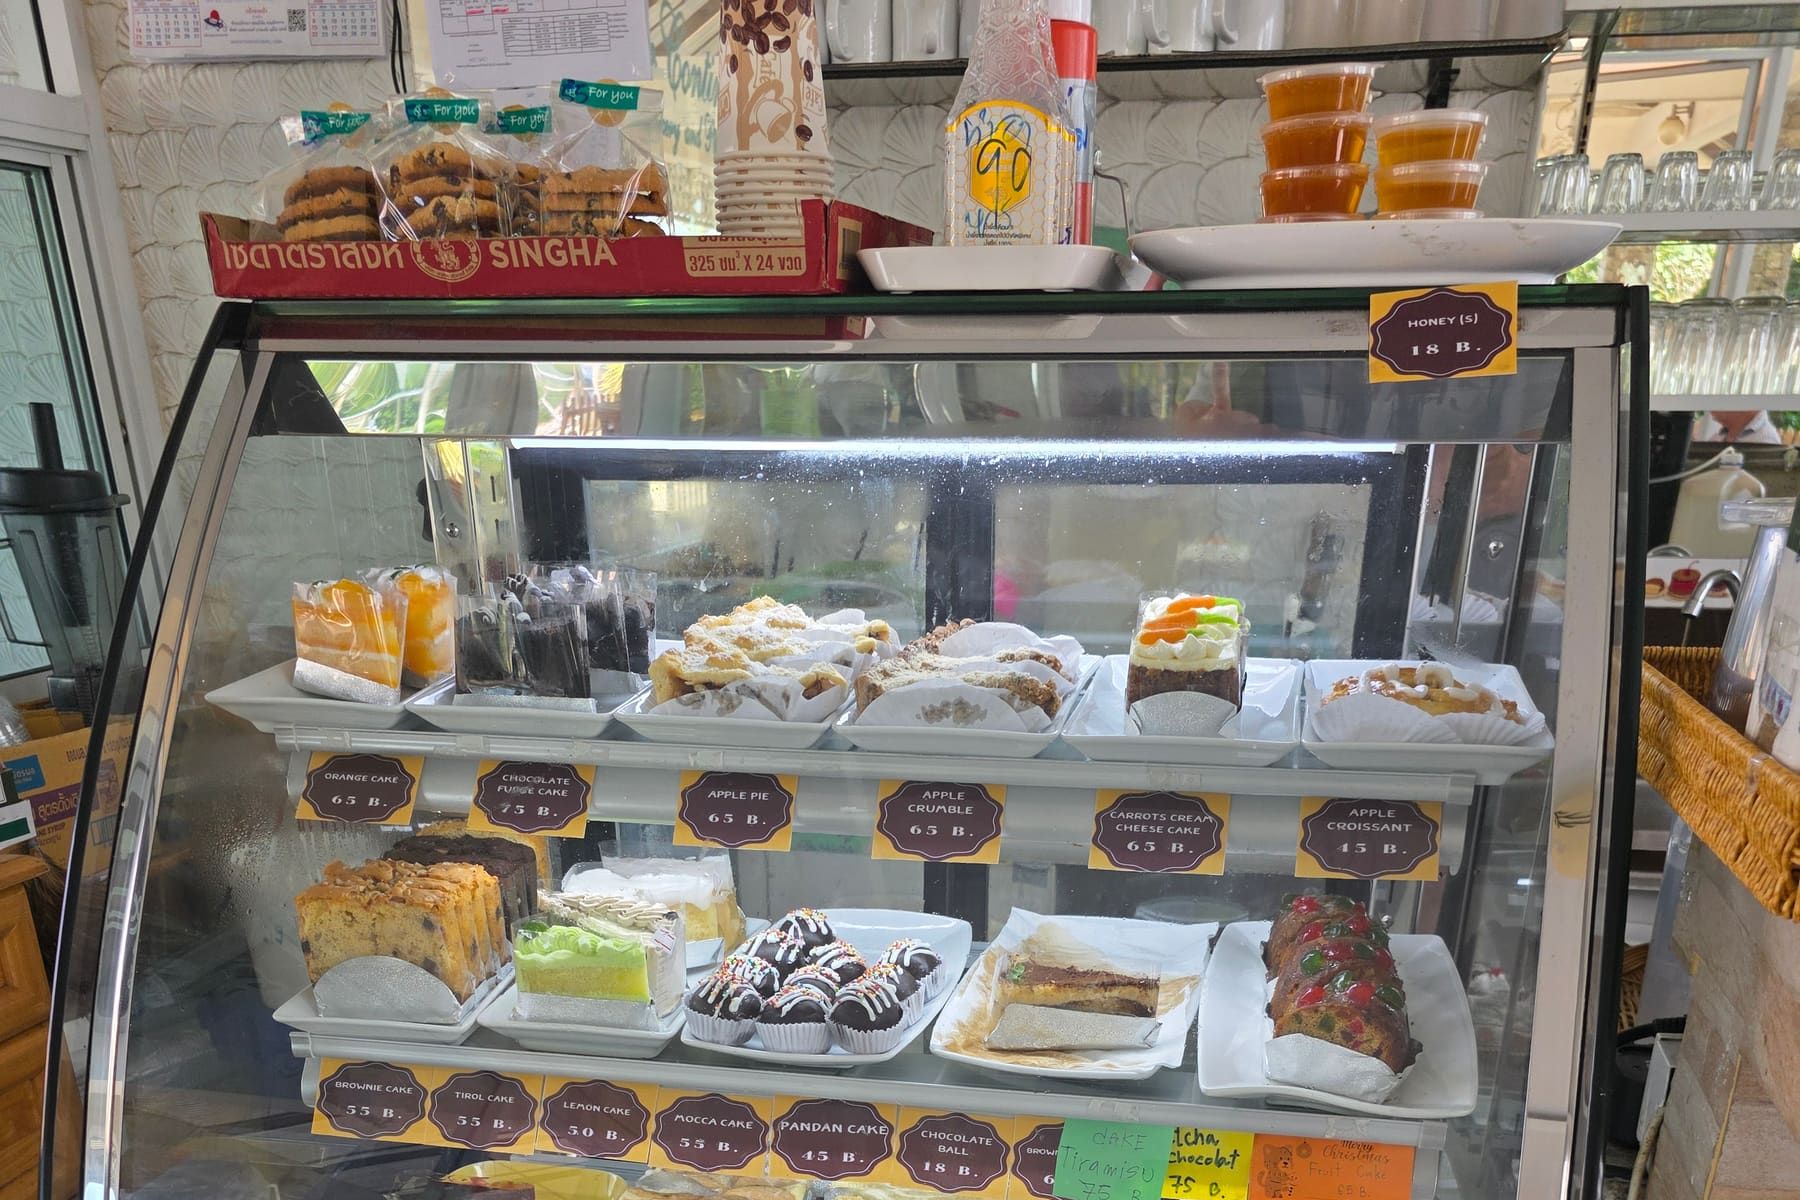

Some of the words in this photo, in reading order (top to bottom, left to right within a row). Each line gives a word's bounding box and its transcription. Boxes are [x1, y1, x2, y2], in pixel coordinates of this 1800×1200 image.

[588, 86, 609, 99] For
[610, 89, 635, 105] you
[433, 104, 453, 116] For
[454, 105, 476, 121] you
[491, 238, 618, 269] SINGHA
[689, 255, 716, 272] 325
[756, 254, 774, 271] 24
[1408, 317, 1457, 328] HONEY
[1459, 312, 1478, 325] (S)
[1411, 343, 1440, 356] 18
[1455, 341, 1482, 353] B.
[324, 772, 369, 783] ORANGE
[371, 774, 399, 784] CAKE
[501, 774, 572, 786] CHOCOLATE
[537, 787, 569, 797] CAKE
[707, 790, 747, 801] APPLE
[750, 791, 769, 801] PIE
[921, 790, 966, 801] APPLE
[331, 794, 357, 805] 65
[368, 796, 388, 807] B.
[500, 802, 526, 815] 75
[536, 805, 558, 817] B.
[907, 804, 974, 816] CRUMBLE
[1109, 810, 1167, 822] CARROTS
[1170, 813, 1215, 824] CREAM
[1348, 808, 1397, 819] APPLE
[708, 812, 734, 825] 65
[746, 814, 767, 825] B.
[909, 824, 938, 836] 65
[951, 825, 974, 837] B.
[1115, 823, 1165, 834] CHEESE
[1167, 825, 1201, 836] CAKE
[1326, 821, 1414, 833] CROISSANT
[1126, 840, 1156, 853] 65
[1170, 842, 1194, 854] B.
[1336, 842, 1367, 854] 45
[1382, 843, 1408, 855] B.
[334, 1081, 383, 1093] BROWNIE
[385, 1084, 414, 1095] CAKE
[455, 1091, 485, 1102] TIROL
[487, 1093, 515, 1104] CAKE
[345, 1104, 371, 1117] 55
[382, 1107, 403, 1120] B.
[563, 1101, 601, 1113] LEMON
[602, 1105, 631, 1117] CAKE
[456, 1115, 481, 1127] 55
[493, 1118, 513, 1131] B.
[674, 1113, 718, 1127] MOCCA
[719, 1117, 754, 1130] CAKE
[780, 1120, 843, 1134] PANDAN
[847, 1122, 890, 1136] CAKE
[567, 1124, 595, 1138] 50
[605, 1128, 626, 1142] B.
[920, 1129, 993, 1147] CHOCOLATE
[1172, 1126, 1220, 1147] tcha
[678, 1137, 706, 1149] 55
[717, 1140, 739, 1154] B.
[937, 1144, 969, 1156] BALL
[1342, 1140, 1377, 1153] Merry
[801, 1149, 829, 1162] 45
[842, 1150, 865, 1164] B.
[1322, 1144, 1392, 1164] Christmas
[921, 1160, 947, 1174] 18
[958, 1164, 979, 1178] B.
[1308, 1161, 1341, 1177] Fruit
[1079, 1179, 1113, 1200] 75
[1168, 1174, 1196, 1194] 75
